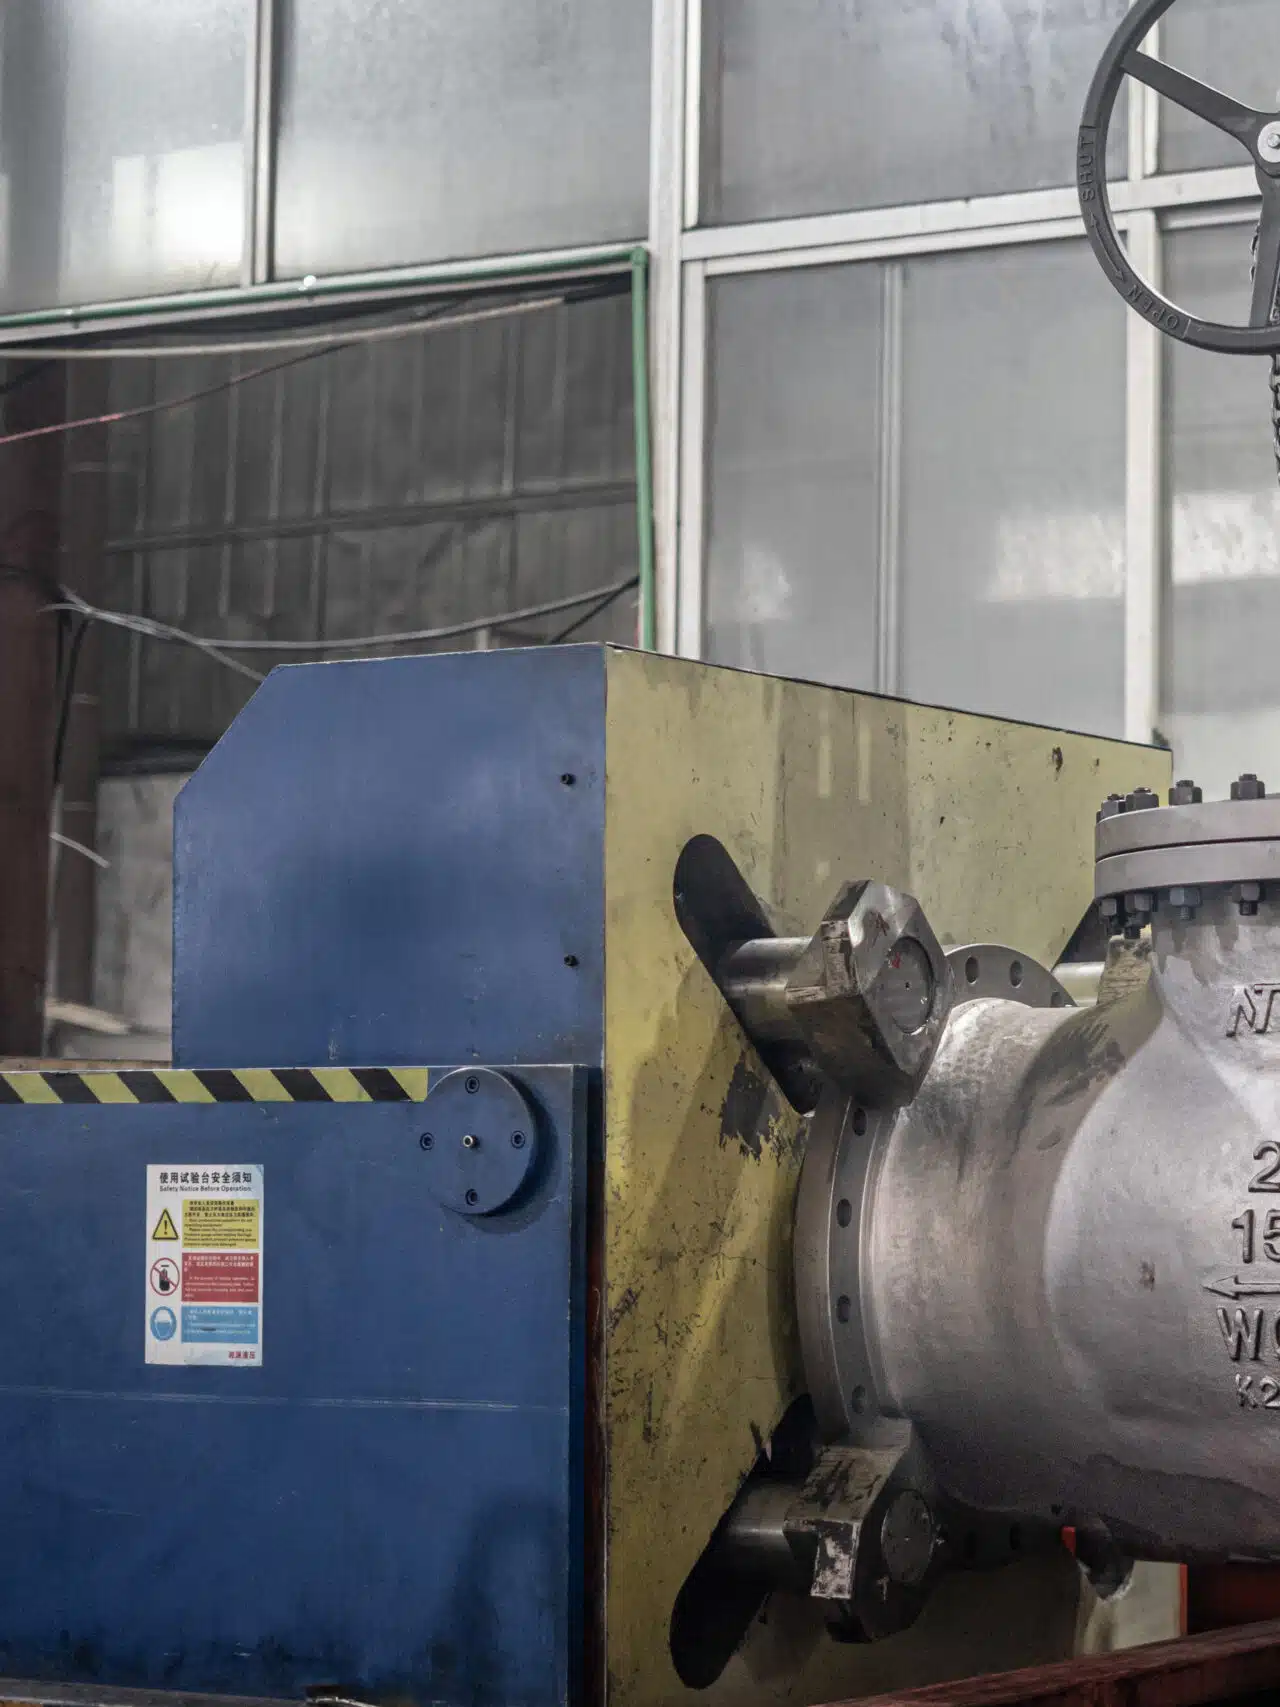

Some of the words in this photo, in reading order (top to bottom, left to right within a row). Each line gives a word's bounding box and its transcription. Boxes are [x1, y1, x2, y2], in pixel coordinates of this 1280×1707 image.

[1079, 135, 1096, 201] SHUT
[1127, 284, 1180, 330] OPEN
[160, 1171, 253, 1184] 使用试验台安全须知
